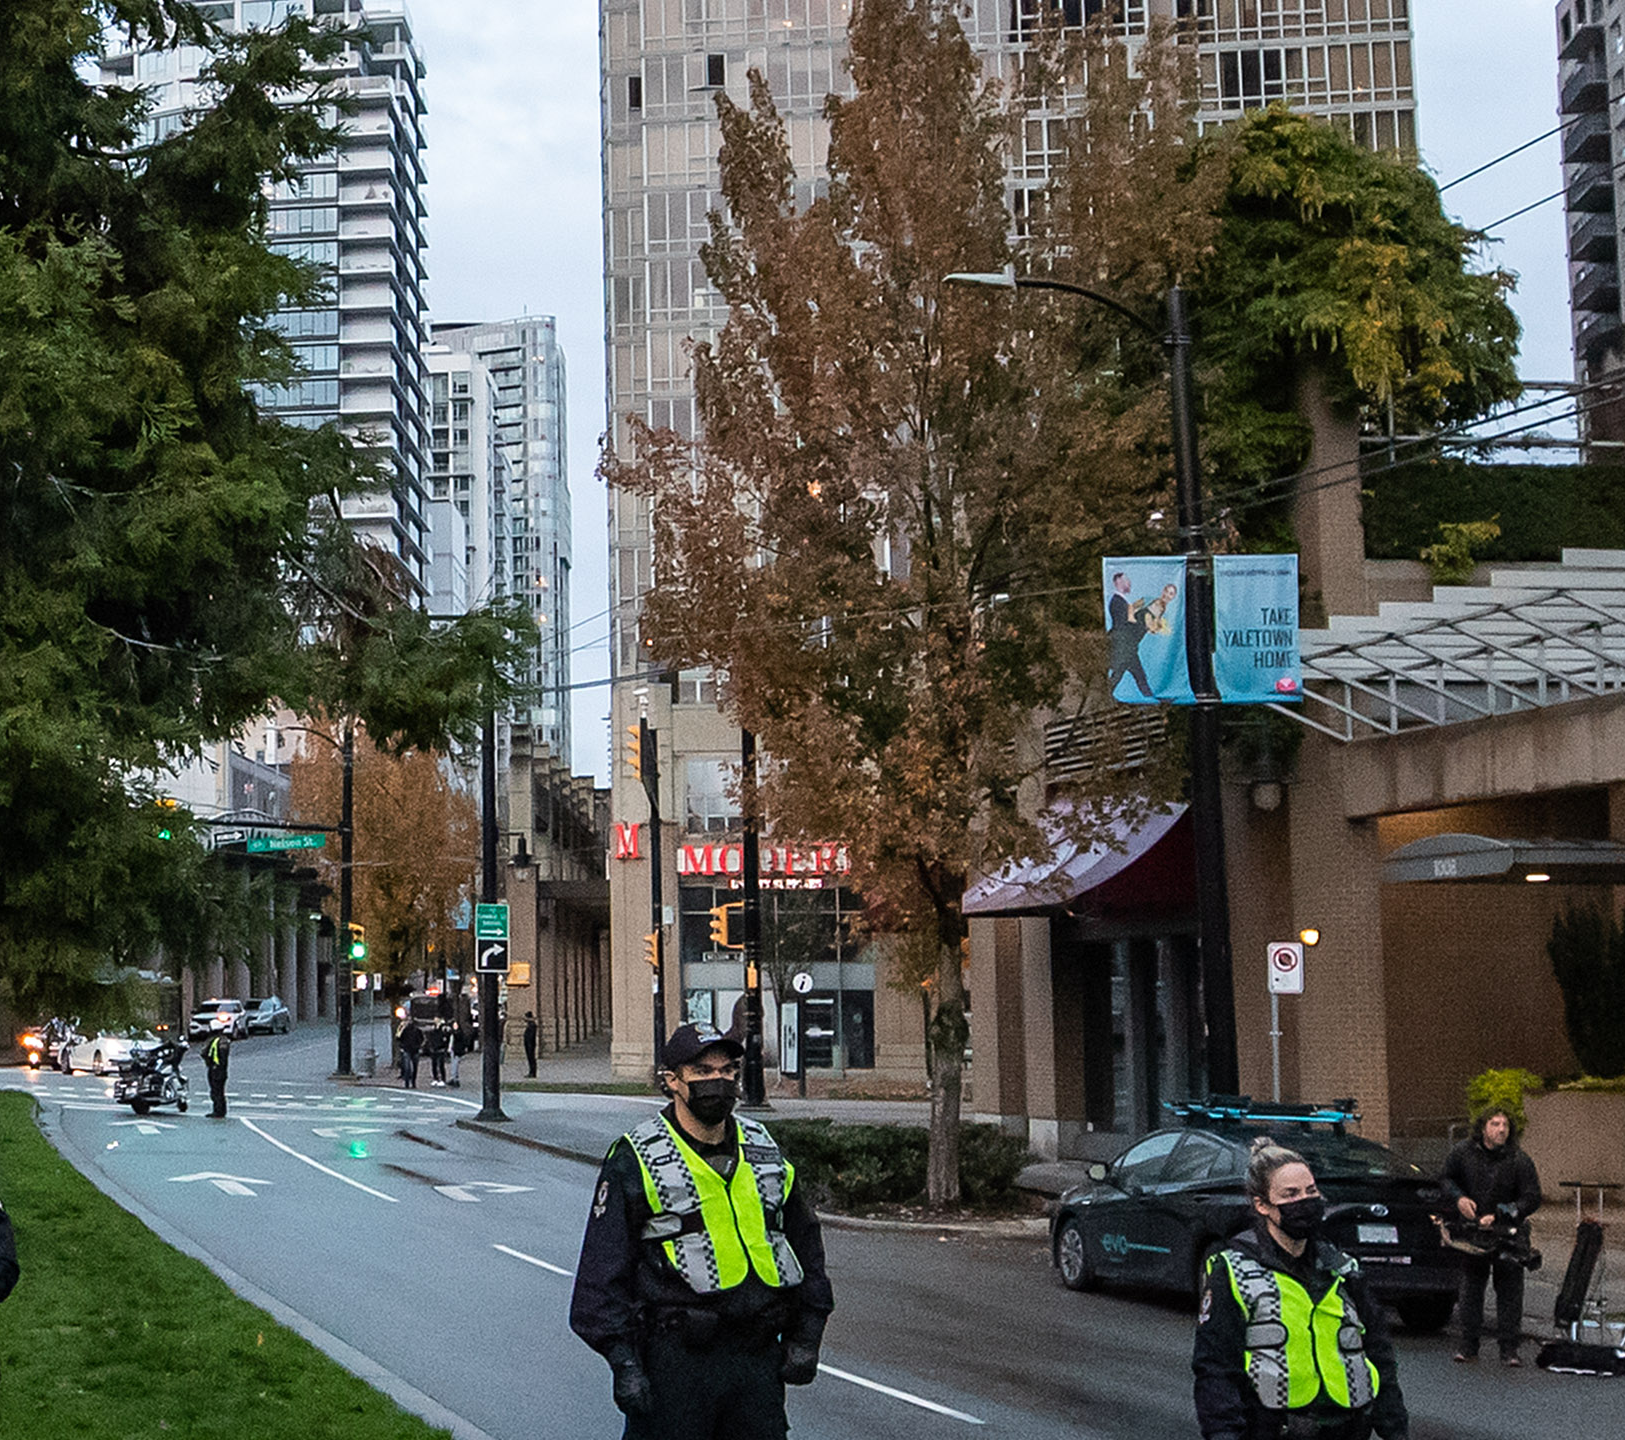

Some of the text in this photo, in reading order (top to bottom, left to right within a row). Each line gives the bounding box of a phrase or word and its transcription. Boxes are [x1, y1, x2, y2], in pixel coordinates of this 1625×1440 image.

[1260, 607, 1292, 626] TAKE
[1223, 629, 1293, 648] YALETOWN
[1253, 650, 1294, 669] HOME
[269, 838, 302, 849] Nelson
[614, 823, 640, 859] M
